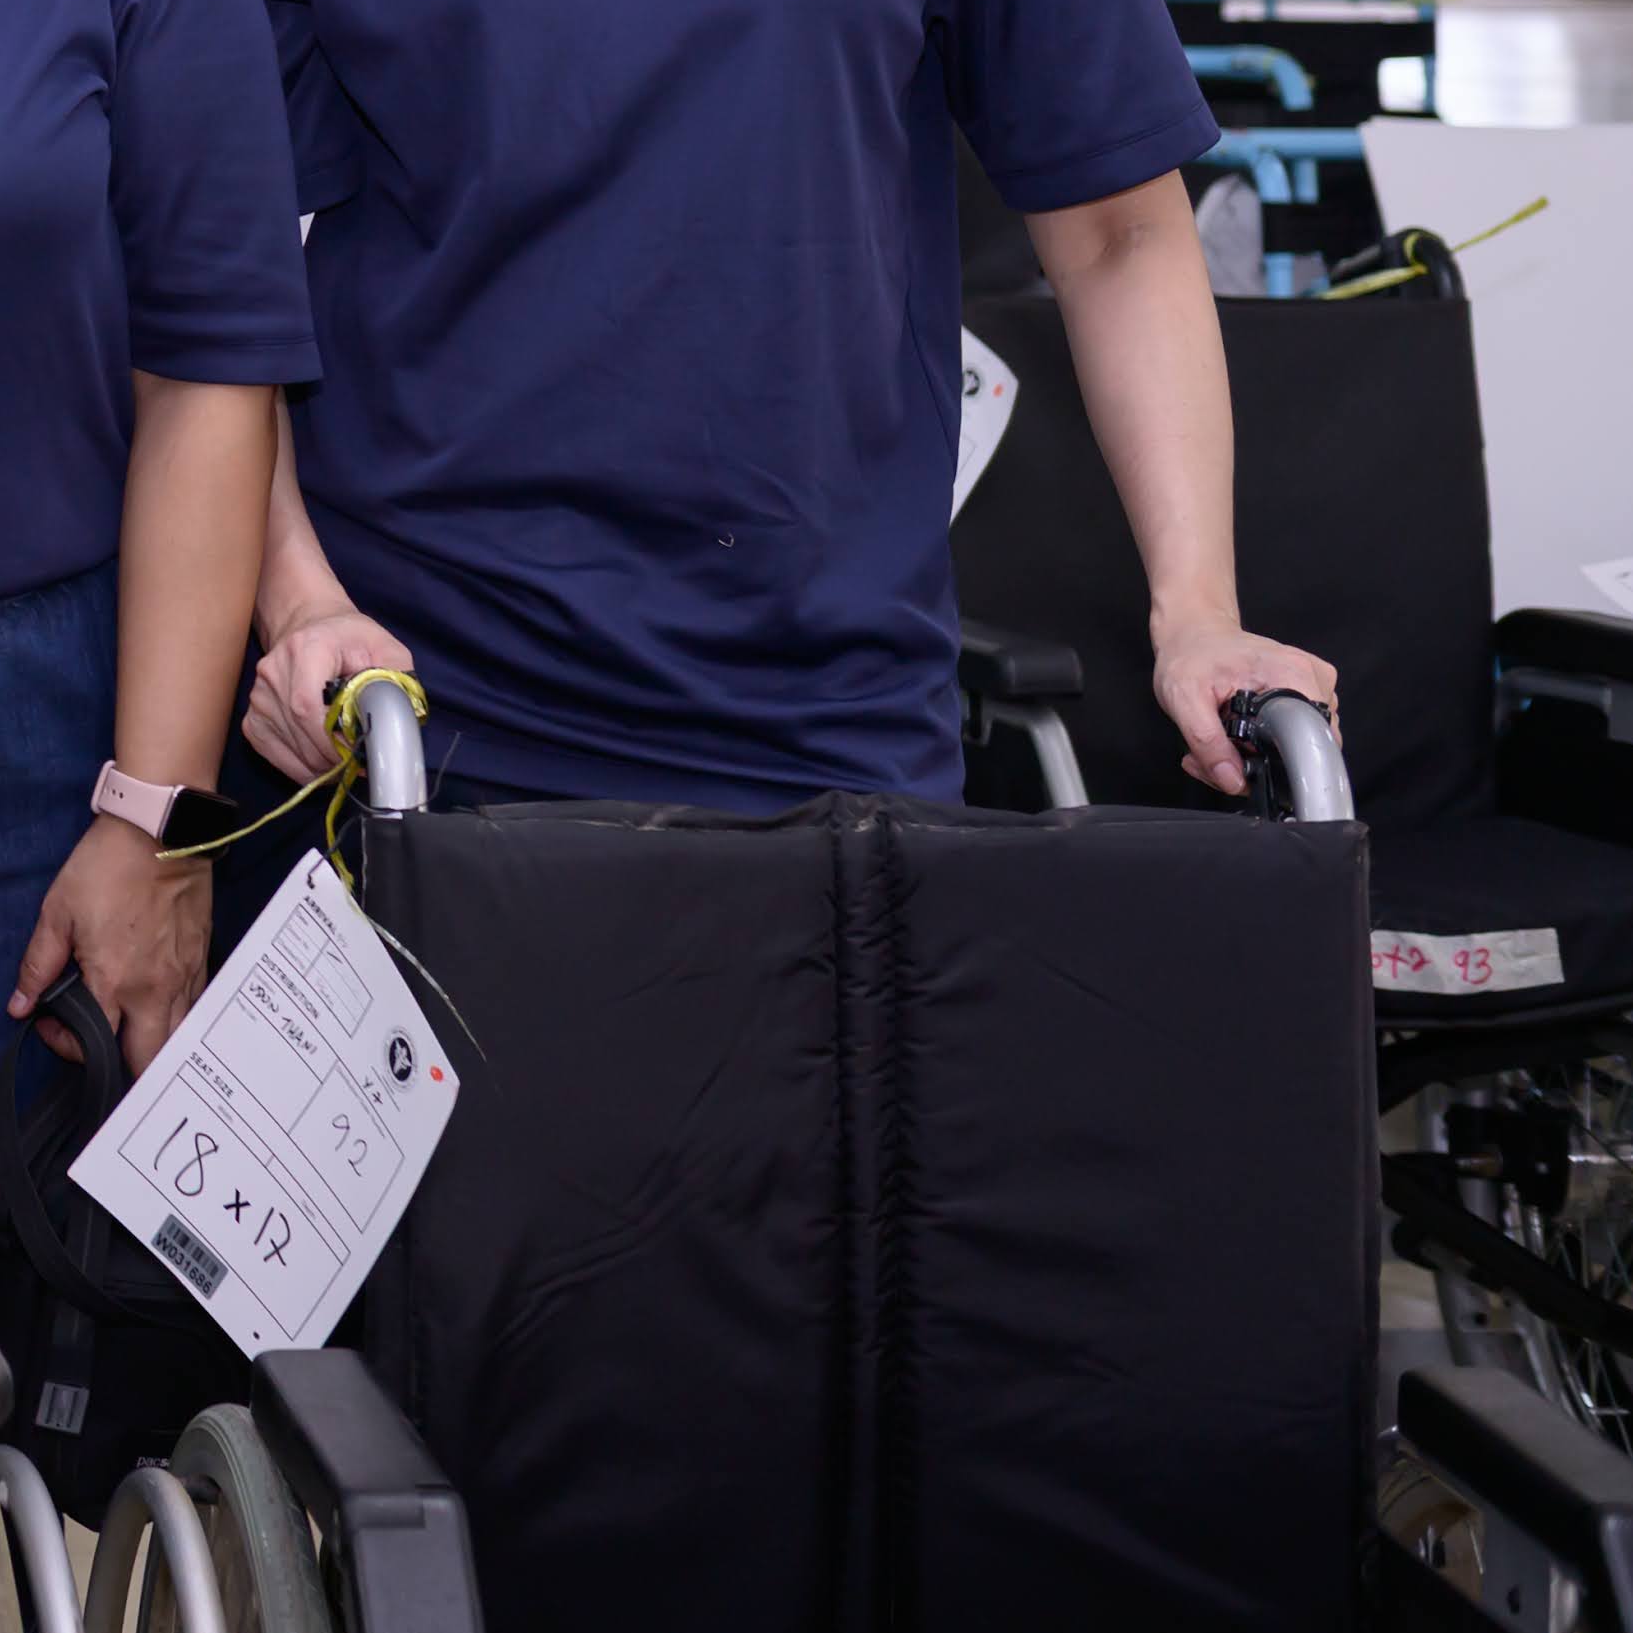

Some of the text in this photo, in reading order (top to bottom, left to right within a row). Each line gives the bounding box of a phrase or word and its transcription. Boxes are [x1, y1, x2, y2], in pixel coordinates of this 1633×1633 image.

[301, 895, 337, 934] ARRIVAL
[260, 954, 320, 1020] DISTRIBUTION
[1453, 947, 1493, 985] 93
[189, 1052, 214, 1076] SEAT
[213, 1075, 234, 1099] SIZE
[153, 1116, 219, 1197] 18
[332, 1114, 367, 1177] 92
[156, 1233, 212, 1294] W031686
[136, 1456, 171, 1468] pacs
